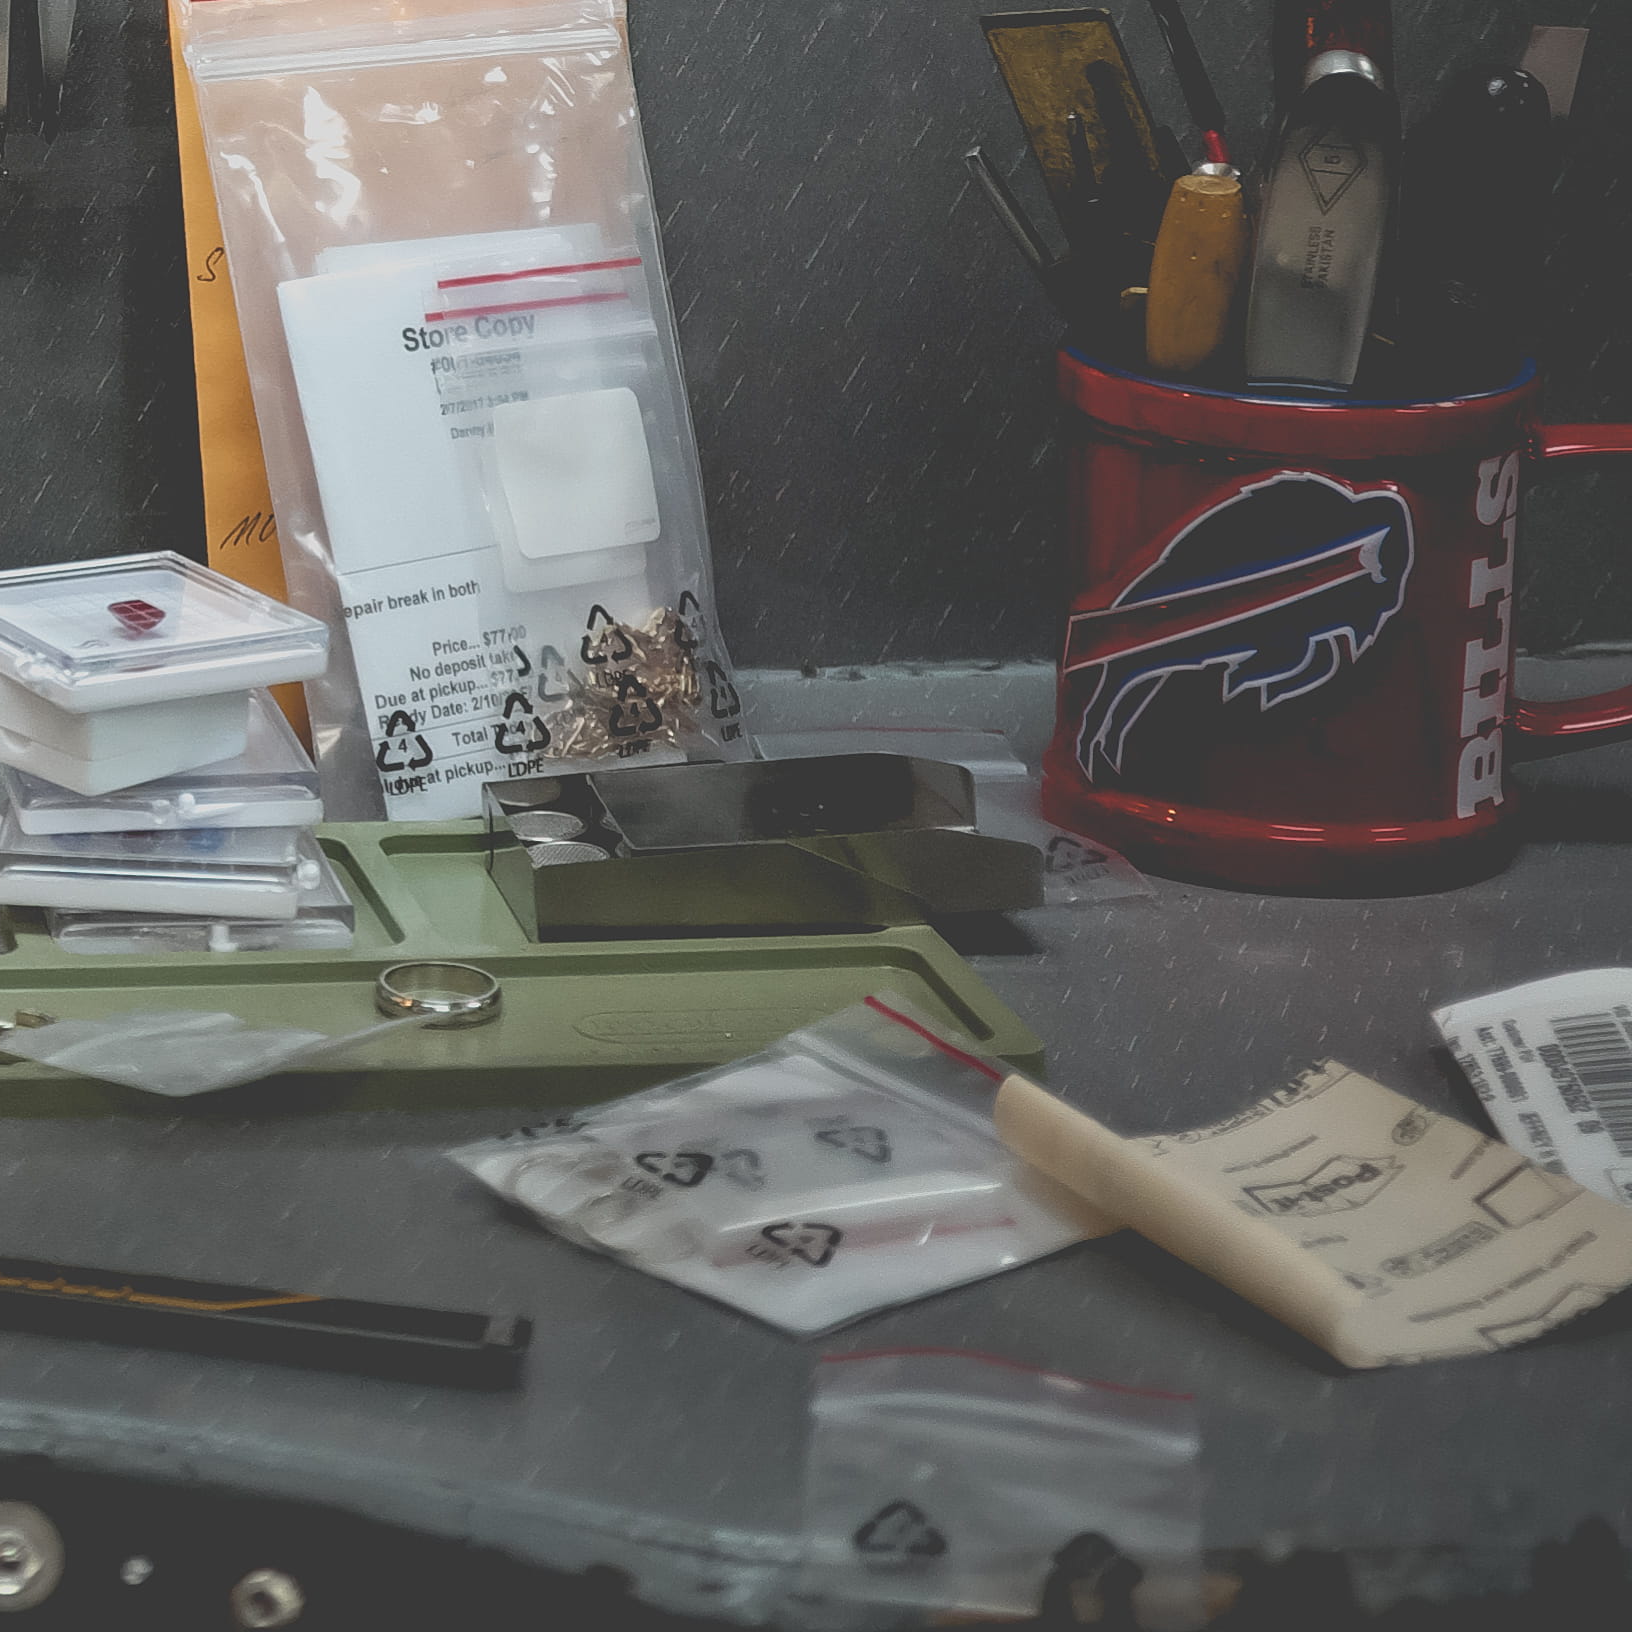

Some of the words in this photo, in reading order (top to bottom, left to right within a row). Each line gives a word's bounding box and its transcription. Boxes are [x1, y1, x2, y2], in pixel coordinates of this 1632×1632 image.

[1317, 229, 1336, 289] PAKISTAN
[401, 324, 469, 352] Store
[473, 313, 536, 342] Copy
[342, 598, 384, 620] epair
[387, 589, 429, 611] break
[432, 587, 446, 601] in
[448, 579, 481, 599] both
[432, 637, 481, 656] Price...
[1457, 450, 1520, 820] BILLS
[410, 667, 431, 682] No
[434, 654, 486, 680] deposit
[374, 692, 407, 710] Due
[411, 688, 426, 703] at
[428, 679, 488, 703] pickup...
[378, 708, 427, 730] Rdy
[431, 701, 469, 720] Date:
[397, 738, 409, 753] 4
[452, 730, 489, 748] Total
[430, 770, 441, 784] at
[444, 759, 506, 782] pickup...
[508, 757, 545, 778] LDPE
